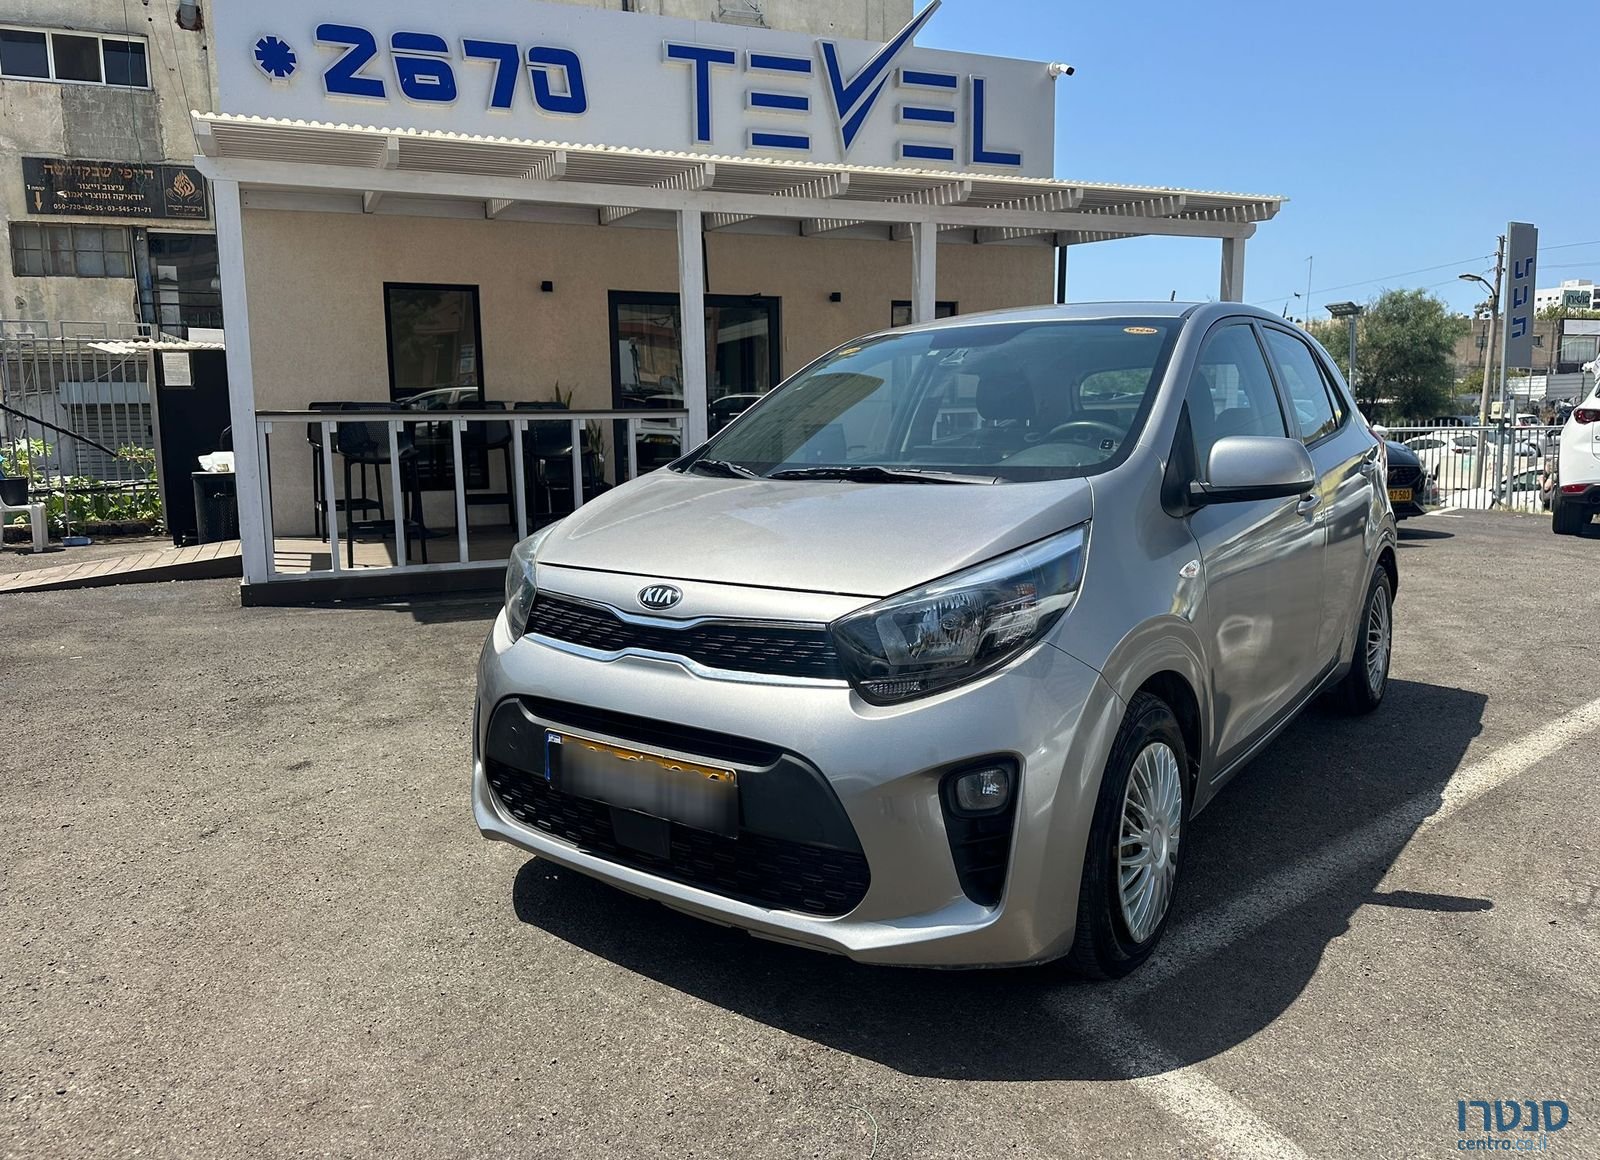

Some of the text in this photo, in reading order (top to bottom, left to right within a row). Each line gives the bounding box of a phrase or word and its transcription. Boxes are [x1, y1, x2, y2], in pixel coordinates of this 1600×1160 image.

[664, 1, 1023, 167] TEVEL
[101, 183, 125, 191] עיצוב
[642, 587, 673, 604] KIA
